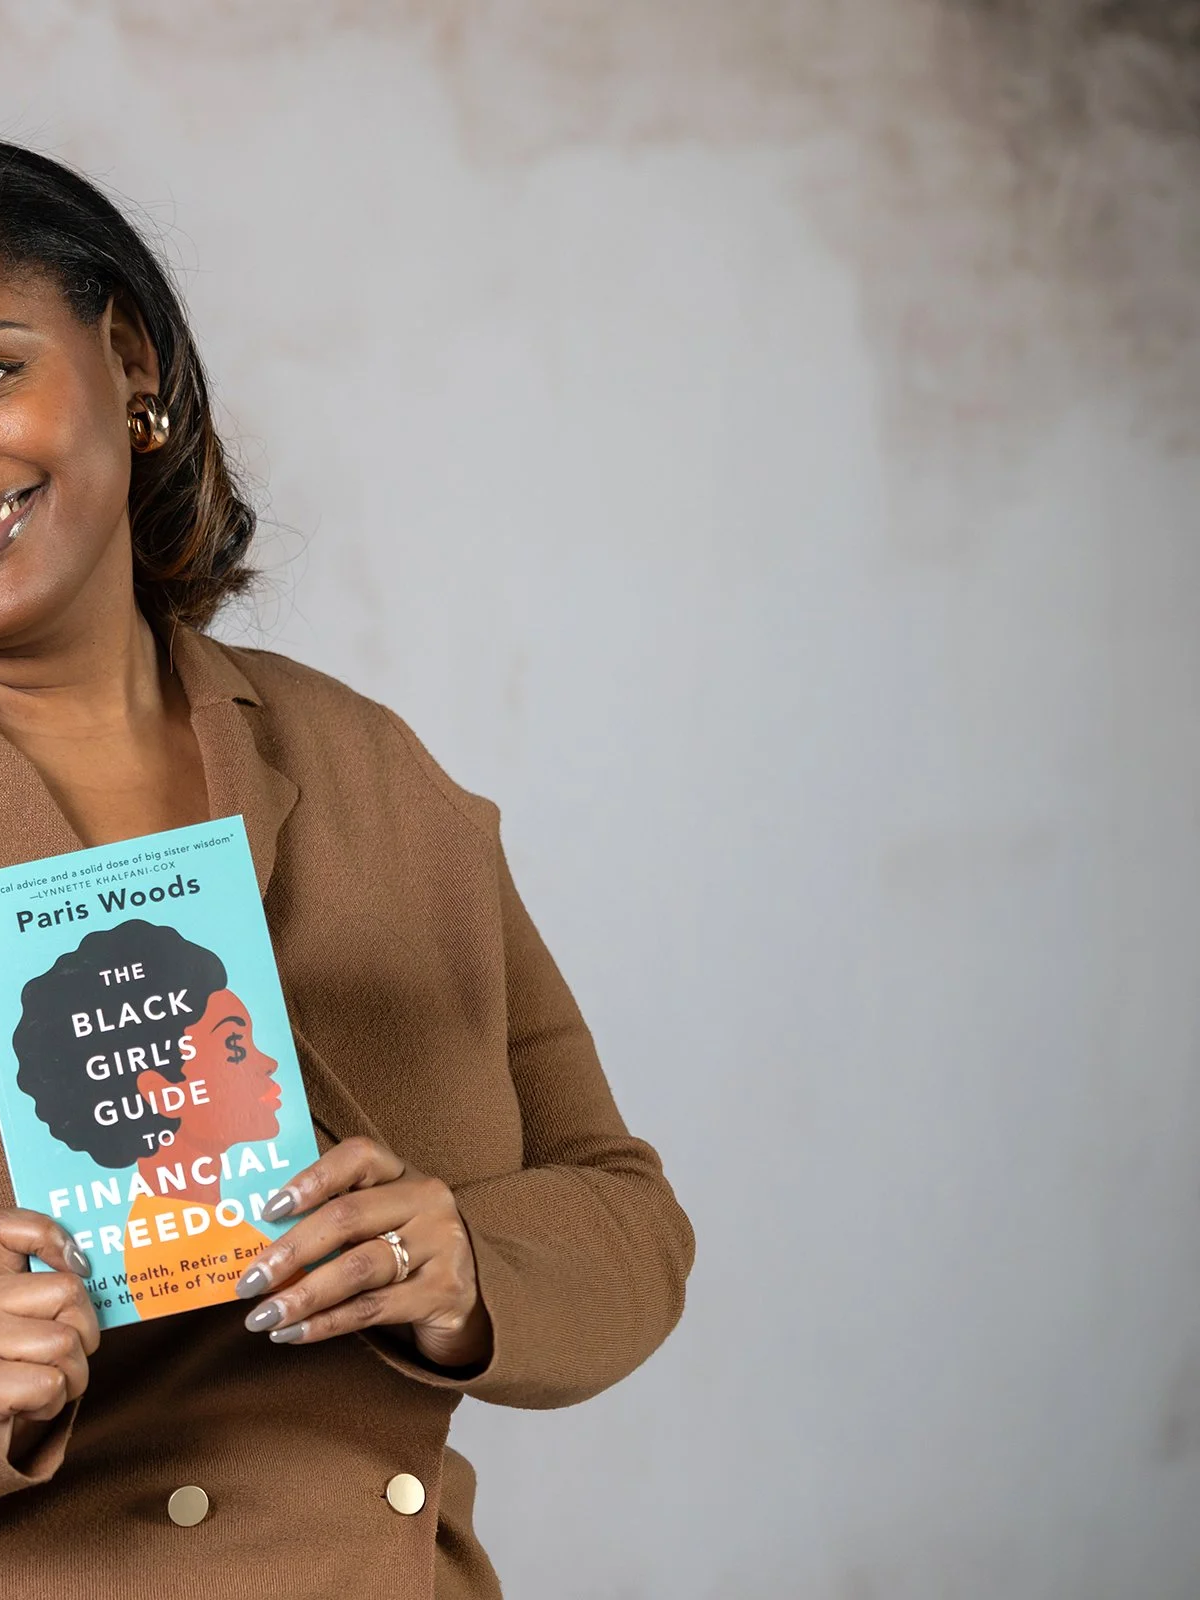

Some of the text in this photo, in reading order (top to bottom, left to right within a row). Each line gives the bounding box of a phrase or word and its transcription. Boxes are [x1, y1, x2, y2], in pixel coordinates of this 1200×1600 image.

[16, 877, 48, 890] advice
[51, 871, 69, 883] and
[71, 870, 78, 878] a
[80, 863, 103, 876] solid
[106, 860, 130, 871] dose
[132, 854, 142, 864] of
[145, 850, 162, 861] big
[163, 844, 191, 857] sister
[95, 860, 177, 886] KHALFANI-COX
[16, 874, 202, 933] Paris Woods
[99, 962, 146, 988] THE
[71, 988, 193, 1039] BLACK
[85, 1034, 198, 1082] GIRL'S
[93, 1079, 211, 1127] GUIDE
[142, 1129, 175, 1151] TO
[48, 1141, 290, 1219] FINANCIAL
[87, 1241, 269, 1294] ild Wealth, Retire Earl
[94, 1268, 243, 1311] ve the Life of Your
